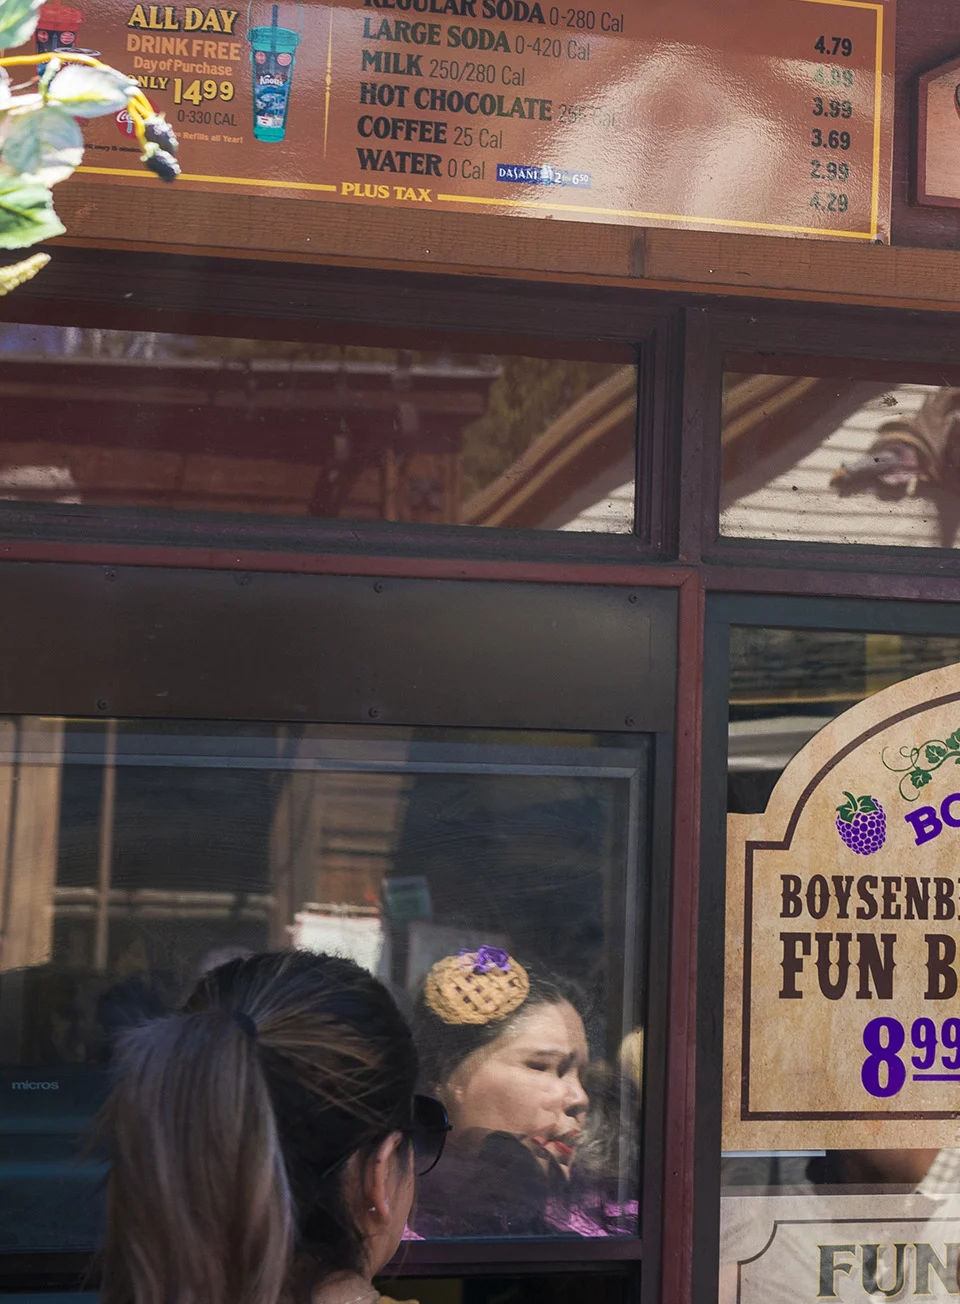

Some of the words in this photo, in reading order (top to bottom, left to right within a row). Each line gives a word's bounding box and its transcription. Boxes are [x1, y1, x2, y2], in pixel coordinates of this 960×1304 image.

[127, 4, 182, 32] ALL
[183, 7, 238, 35] DAY
[550, 6, 595, 30] 0-280
[600, 11, 624, 33] Cal
[127, 34, 188, 56] DRINK
[192, 39, 242, 61] FREE
[363, 17, 441, 46] LARGE
[447, 25, 511, 53] SODA
[515, 35, 562, 58] 0-420
[567, 40, 591, 61] Cal
[814, 35, 853, 57] 4.79
[134, 56, 158, 74] Day
[159, 59, 173, 72] of
[174, 60, 233, 76] Purchase
[361, 50, 423, 77] MILK
[429, 59, 496, 84] 250/280
[501, 67, 525, 86] Cal
[359, 82, 409, 108] HOT
[413, 87, 553, 121] CHOCOLATE
[177, 109, 211, 124] 0-330
[214, 112, 238, 126] CAL
[357, 115, 448, 144] COFFEE
[453, 126, 473, 146] 25
[478, 128, 503, 149] Cal
[811, 128, 851, 150] 3.69
[356, 147, 443, 177] WATER
[447, 159, 457, 177] 0
[461, 161, 485, 180] Cal
[499, 167, 538, 180] DASANI
[554, 172, 562, 183] 2
[341, 181, 390, 200] PLUS
[393, 186, 432, 202] TAX
[778, 932, 897, 1001] FUN
[12, 1080, 59, 1090] micros
